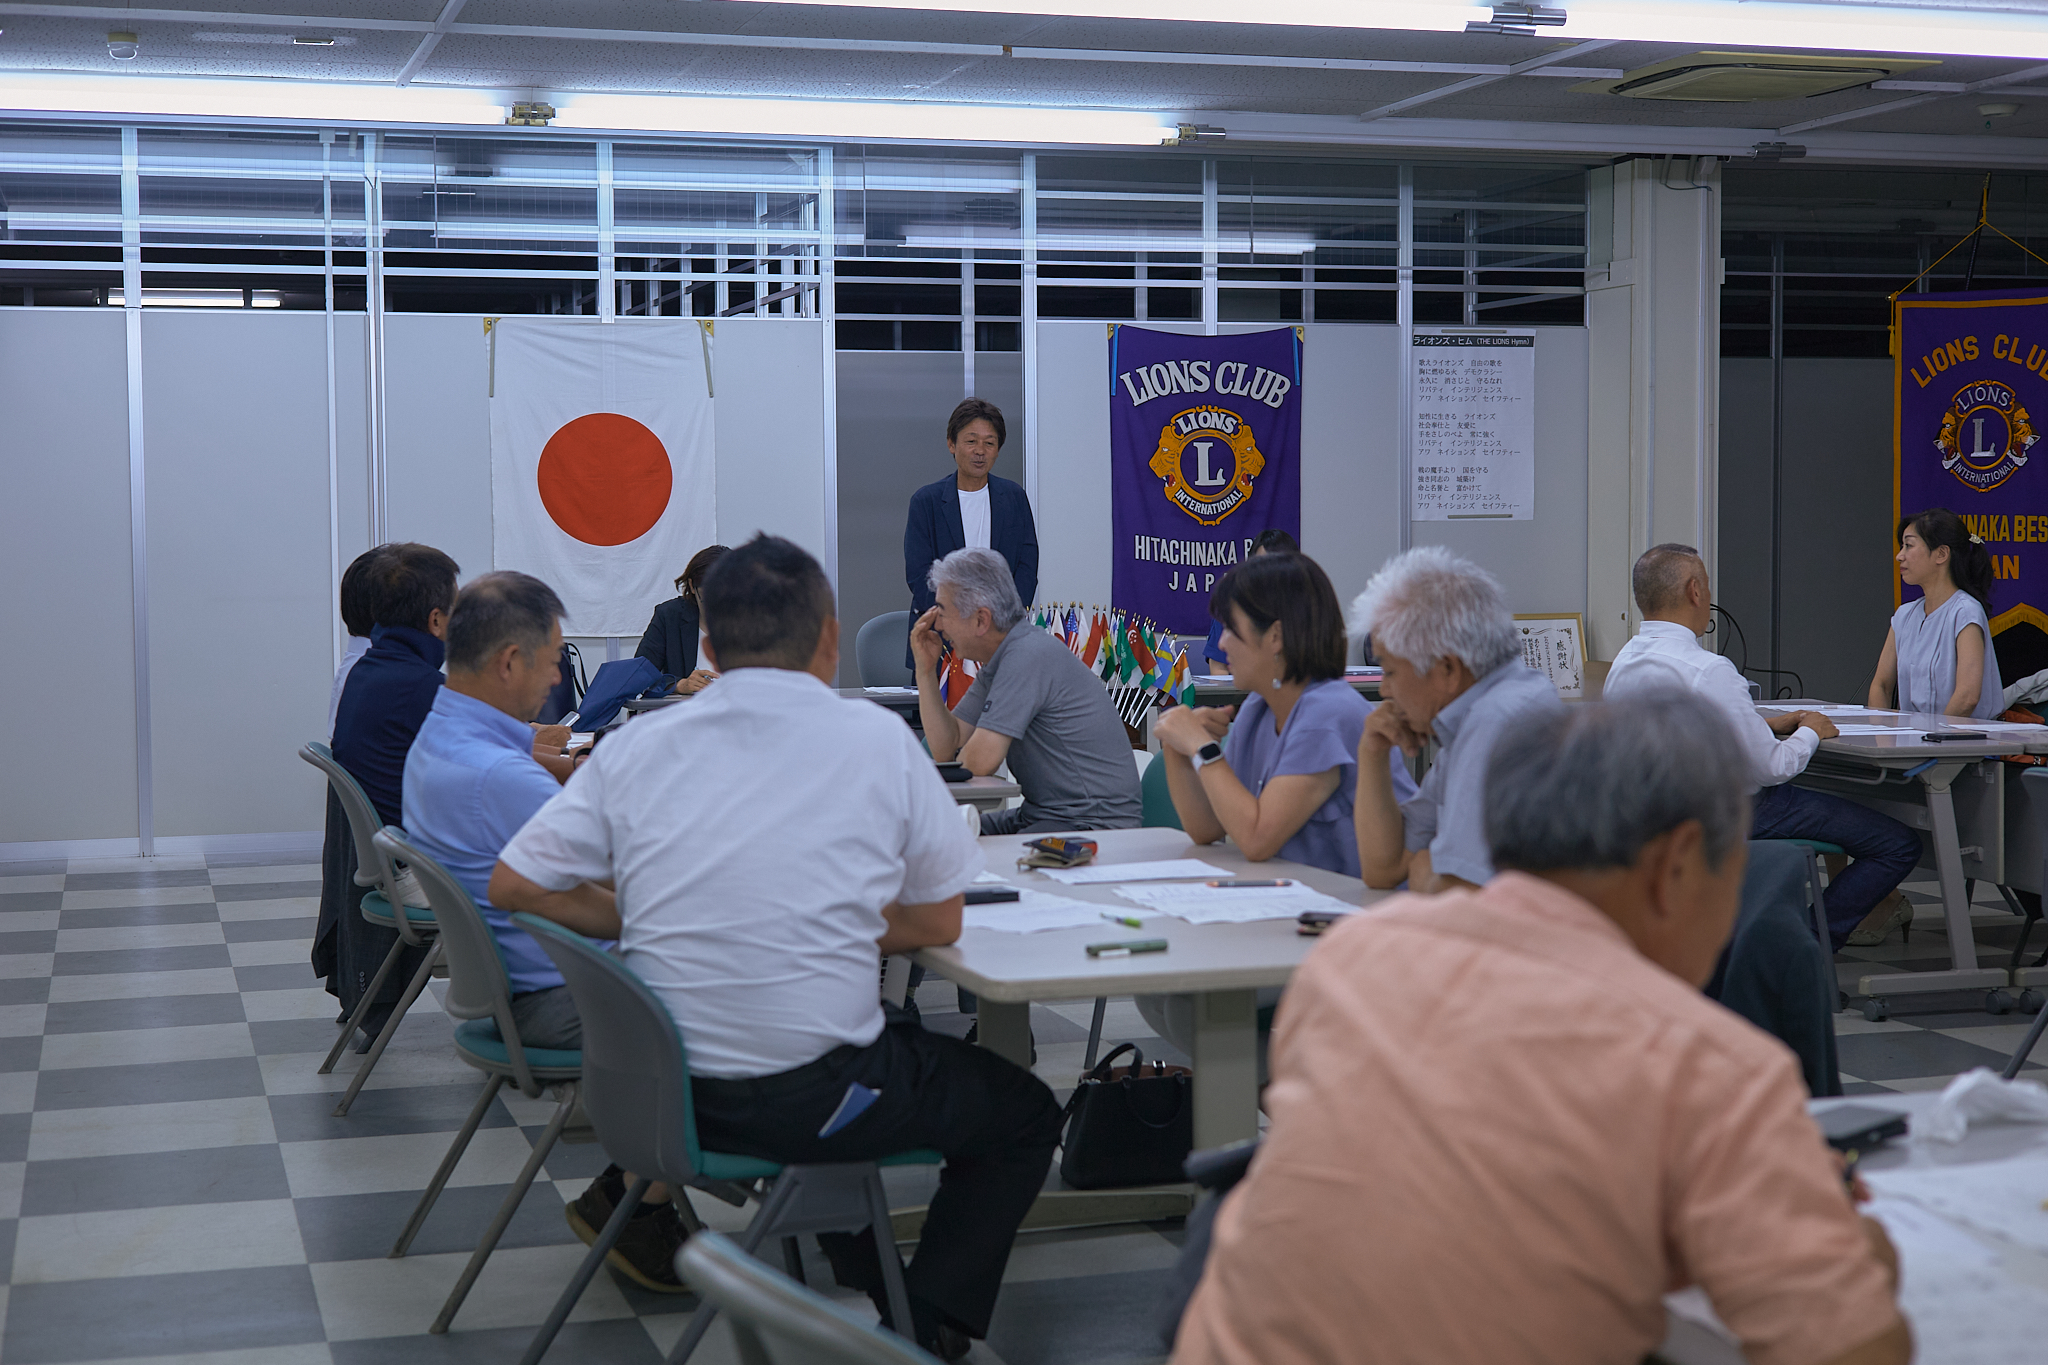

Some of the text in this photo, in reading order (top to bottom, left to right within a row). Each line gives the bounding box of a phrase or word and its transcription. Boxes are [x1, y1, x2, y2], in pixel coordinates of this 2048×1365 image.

[1413, 336, 1473, 345] ライオンズ・ヒム
[1492, 338, 1510, 346] LIONS
[1910, 335, 1980, 388] LIONS
[1119, 360, 1291, 409] LIONS CLUB
[1956, 386, 2010, 410] LIONS
[1175, 411, 1238, 434] LIONS
[1464, 413, 1496, 421] ライオンズ
[1970, 418, 1996, 458] L
[1193, 441, 1226, 486] L
[1953, 461, 2015, 483] INTERNATIONAL
[1174, 489, 1243, 516] INTERNATIONAL
[1134, 534, 1238, 567] HITACHINAKA
[1168, 571, 1228, 592] JAP
